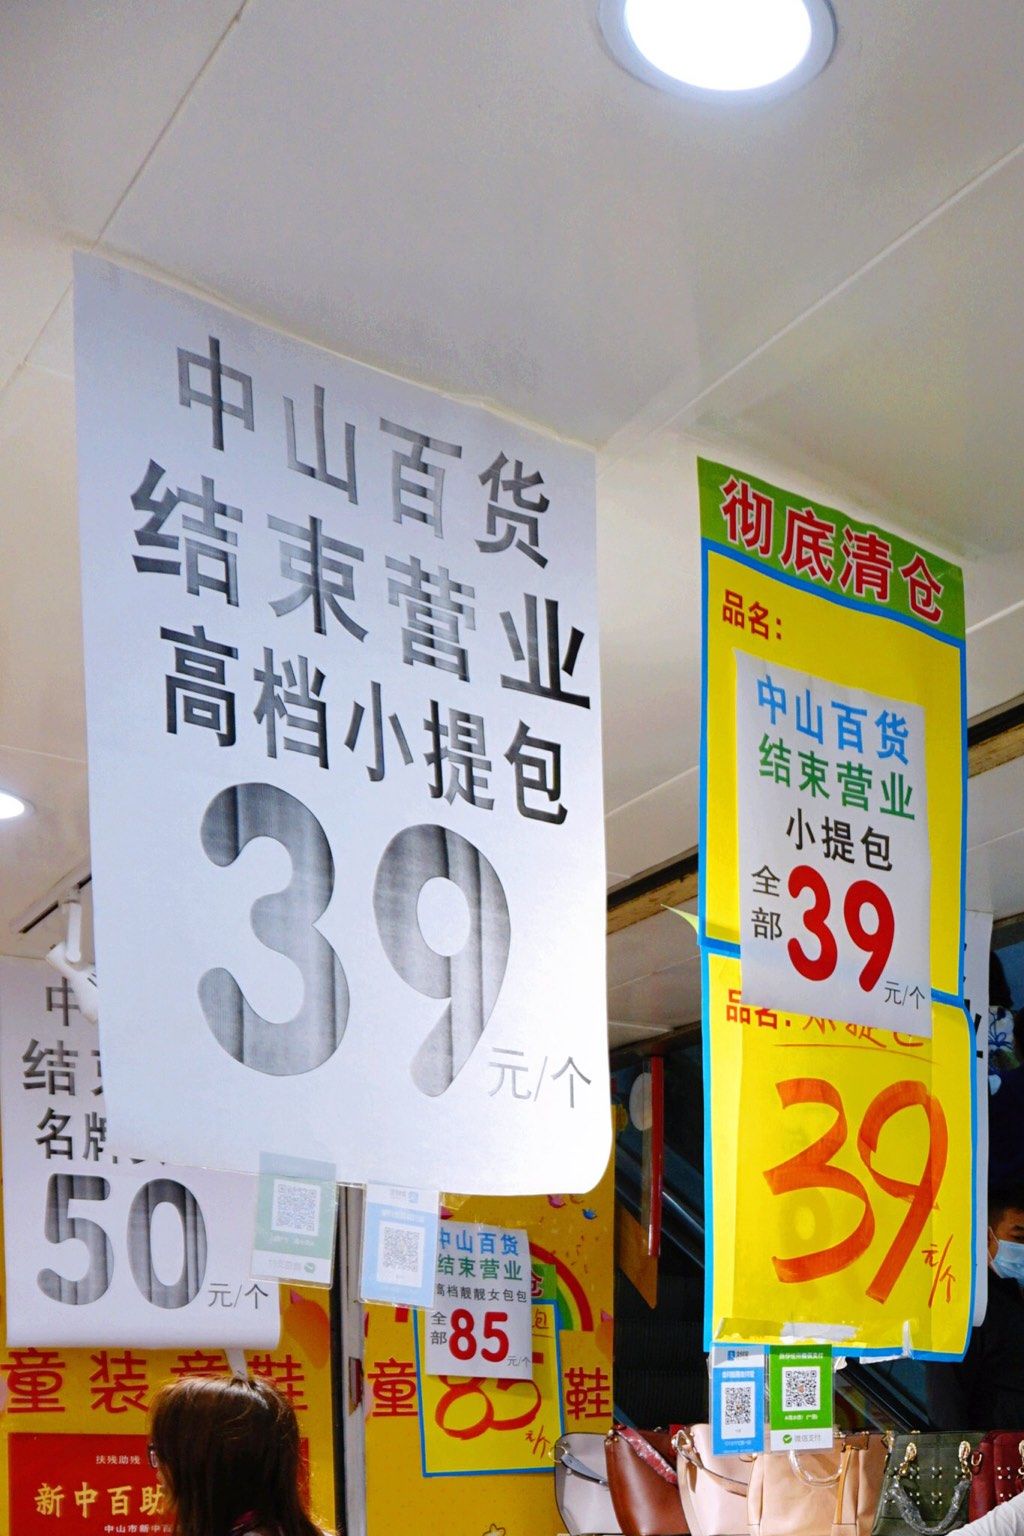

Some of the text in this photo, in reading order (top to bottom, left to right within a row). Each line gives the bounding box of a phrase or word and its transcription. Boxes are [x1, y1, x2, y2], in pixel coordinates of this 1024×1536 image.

[176, 335, 551, 569] 中山百货
[130, 458, 591, 710] 结束营业
[719, 474, 945, 624] 彻底清仓
[159, 624, 568, 825] 高档小提包
[756, 674, 909, 766] 中山百货
[758, 732, 916, 822] 结束营业
[785, 807, 894, 873] 小提包
[197, 782, 592, 1109] 39 元/个
[751, 863, 784, 943] 全部
[787, 863, 896, 994] 39
[884, 980, 927, 1011] 元/个
[762, 1076, 949, 1305] 39
[35, 1172, 269, 1309] 50 元/个
[436, 1252, 523, 1281] 结束营业
[439, 1226, 520, 1257] 中山百货
[430, 1310, 448, 1346] 全部
[436, 1283, 528, 1303] 高档靓靓女包包
[448, 1308, 531, 1369] 85 元/个
